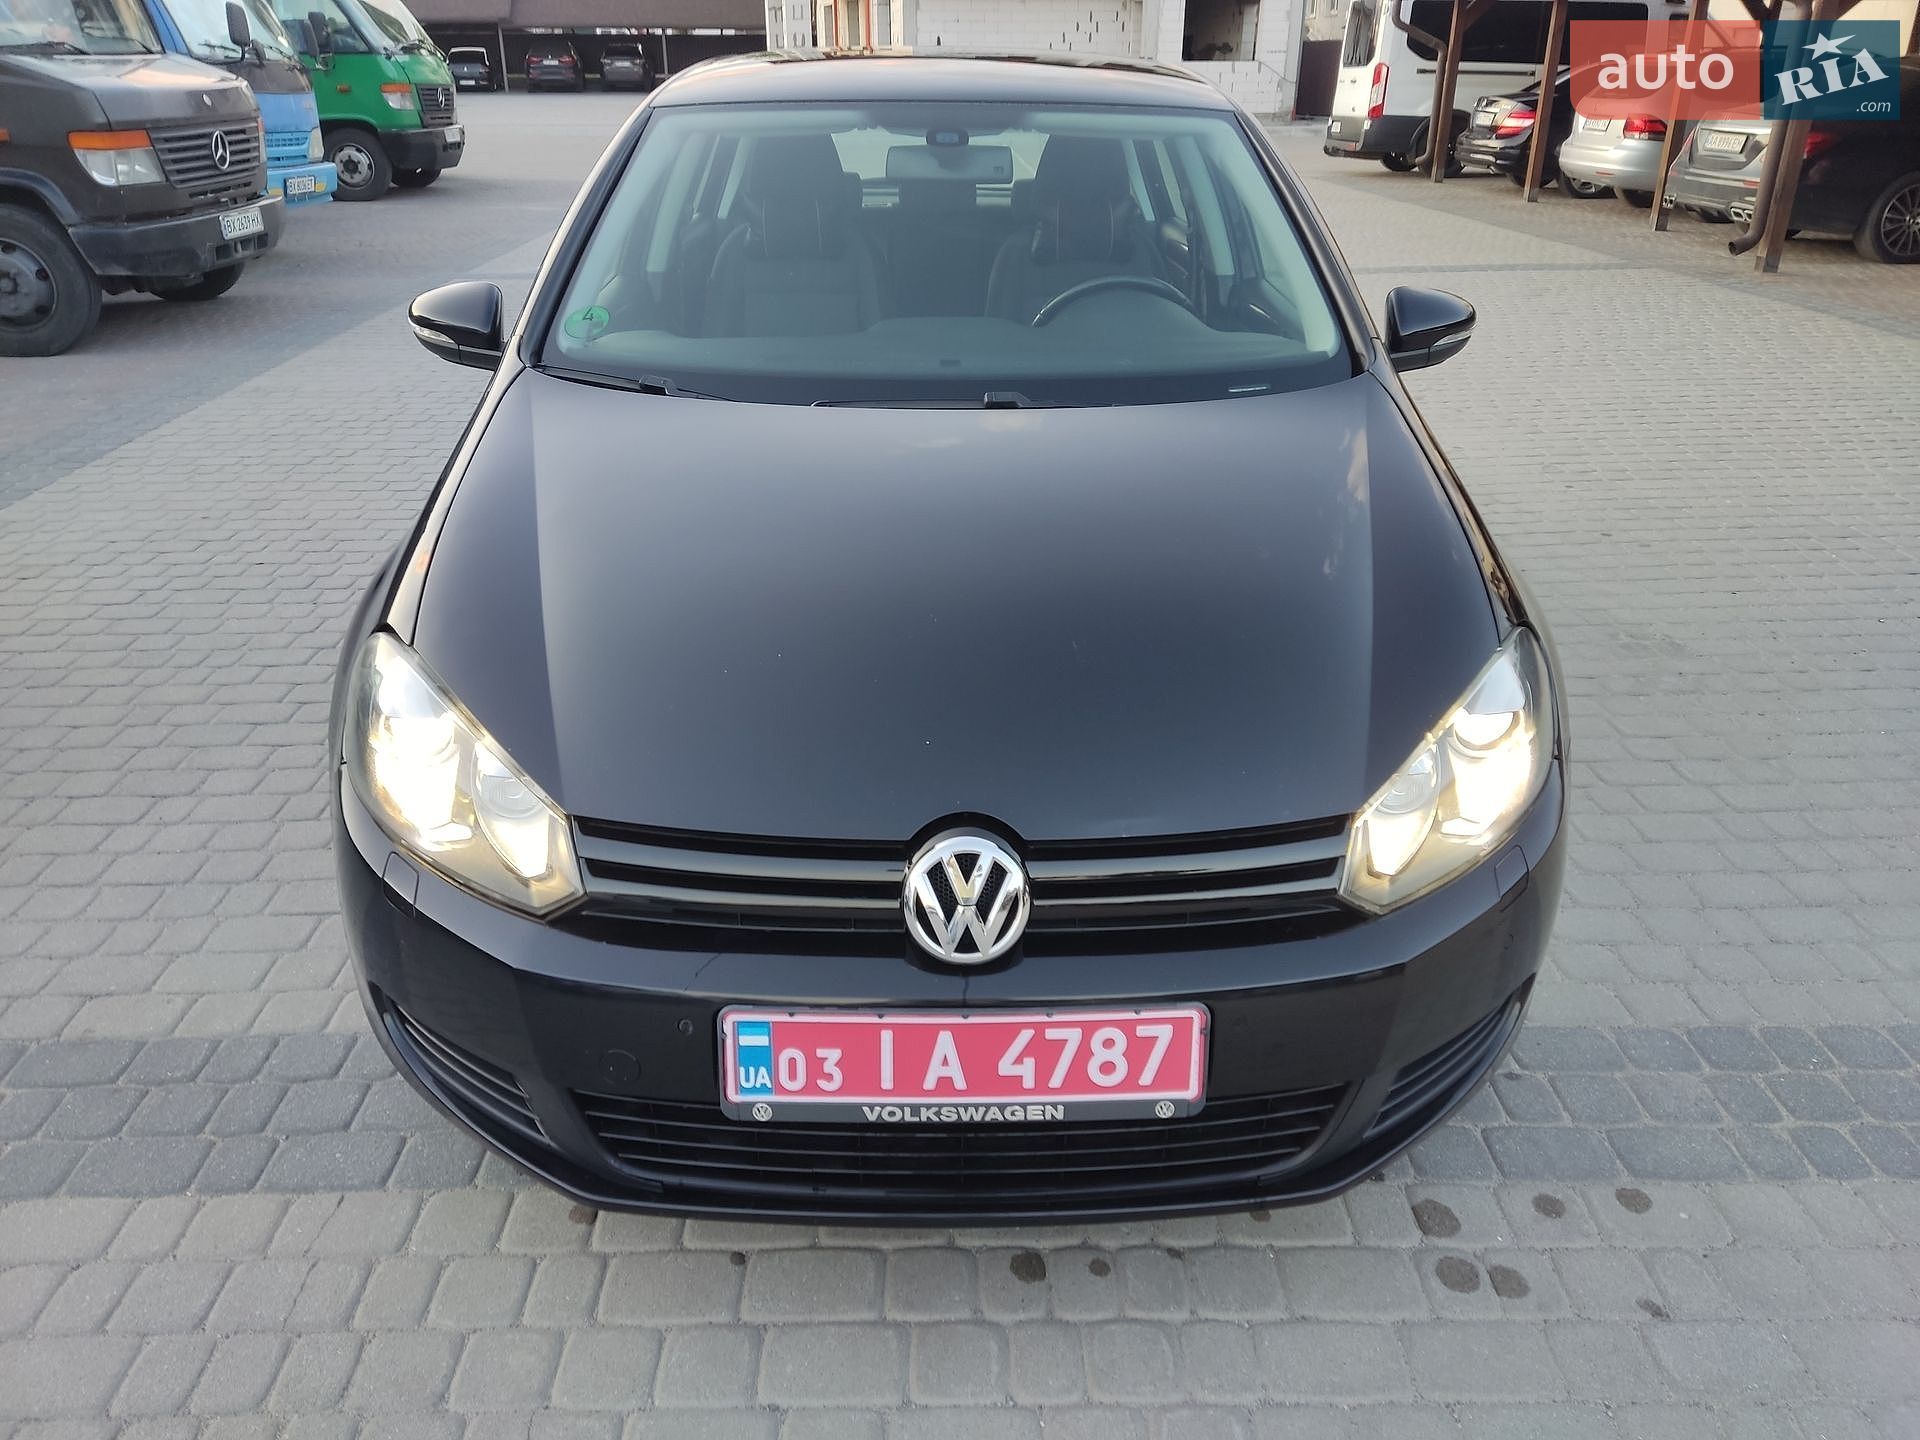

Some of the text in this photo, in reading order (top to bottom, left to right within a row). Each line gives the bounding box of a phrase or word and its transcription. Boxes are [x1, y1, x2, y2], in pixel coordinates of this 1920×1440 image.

[778, 1024, 1175, 1092] 03 IA 4787
[739, 1066, 772, 1089] UA
[862, 1104, 1065, 1122] VOLKSWAGEN
